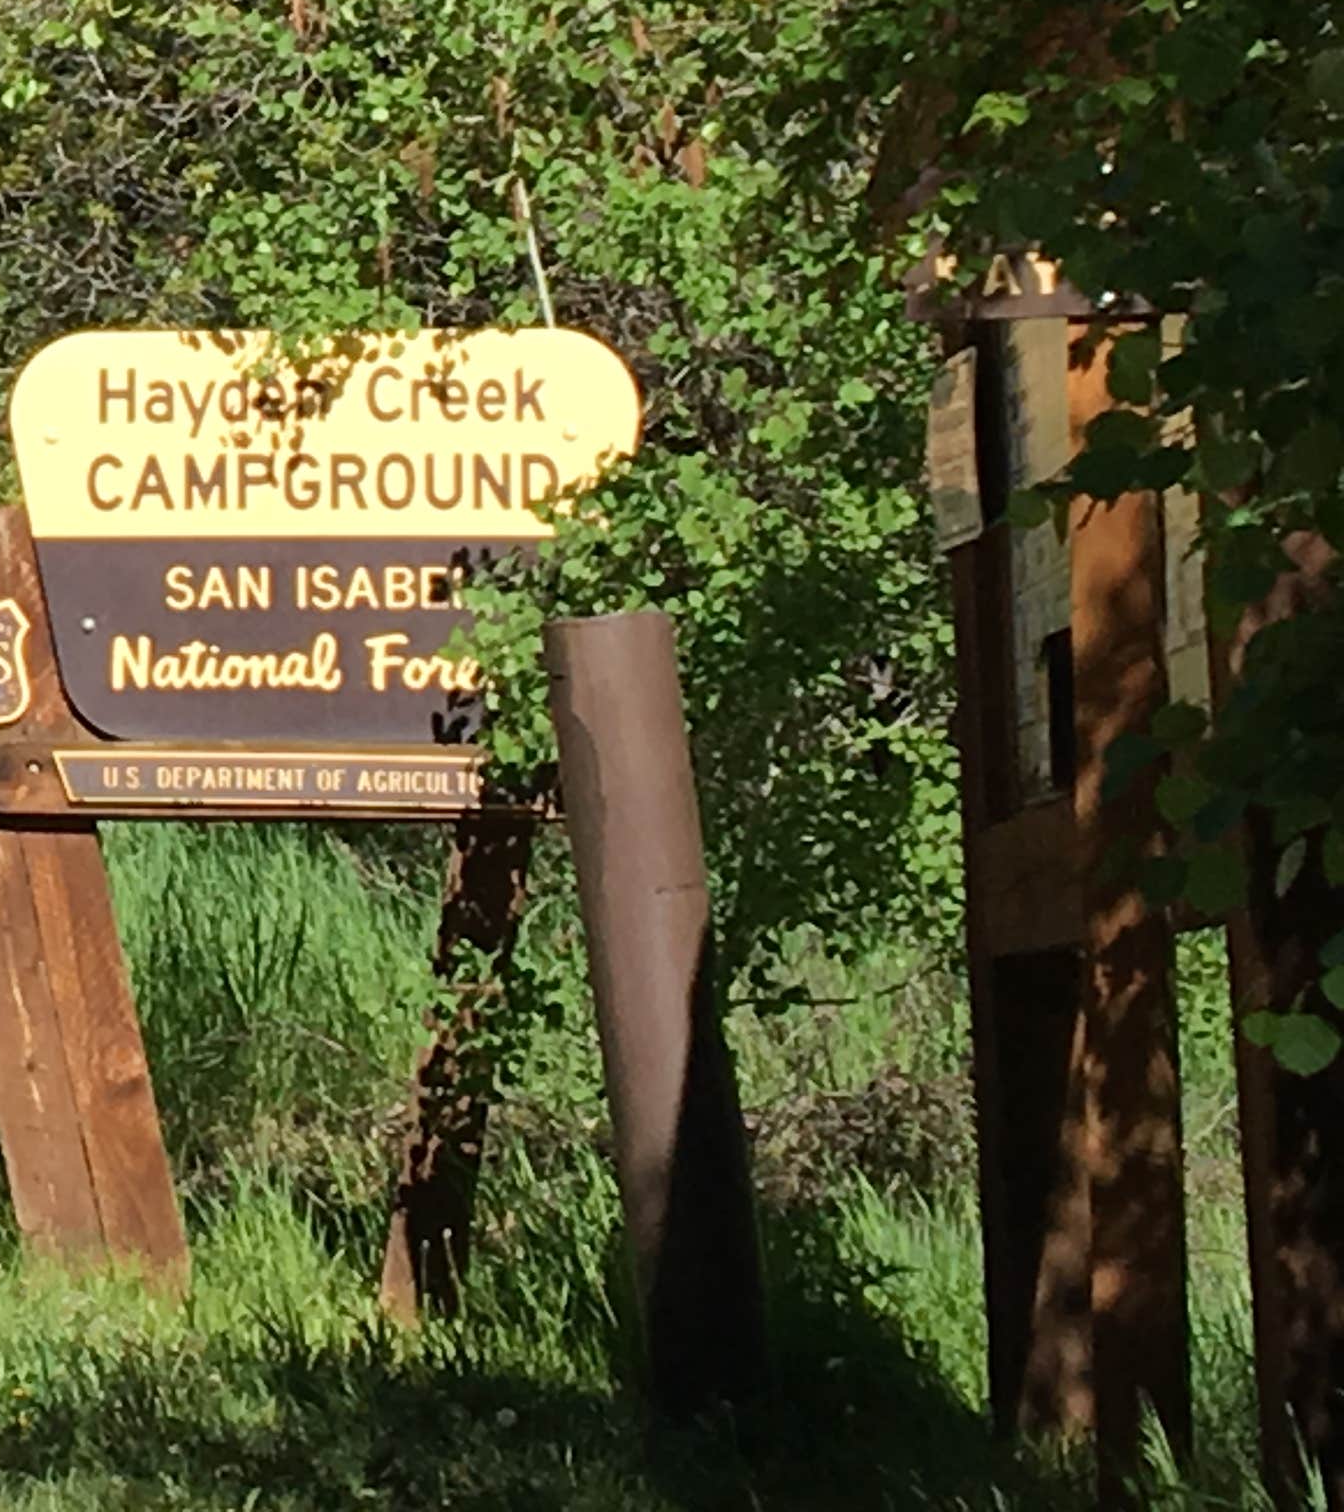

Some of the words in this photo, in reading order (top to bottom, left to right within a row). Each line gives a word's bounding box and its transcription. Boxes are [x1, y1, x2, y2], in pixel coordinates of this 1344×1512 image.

[97, 367, 329, 438] Hayden
[365, 366, 545, 422] Creek
[86, 452, 559, 511] CAMPGROUND
[164, 565, 270, 611] SAN
[111, 631, 341, 691] National
[364, 633, 488, 691] Fore
[156, 765, 305, 792] DEPARTMENT
[316, 768, 346, 792] OF
[357, 769, 485, 798] AGRICULTU
